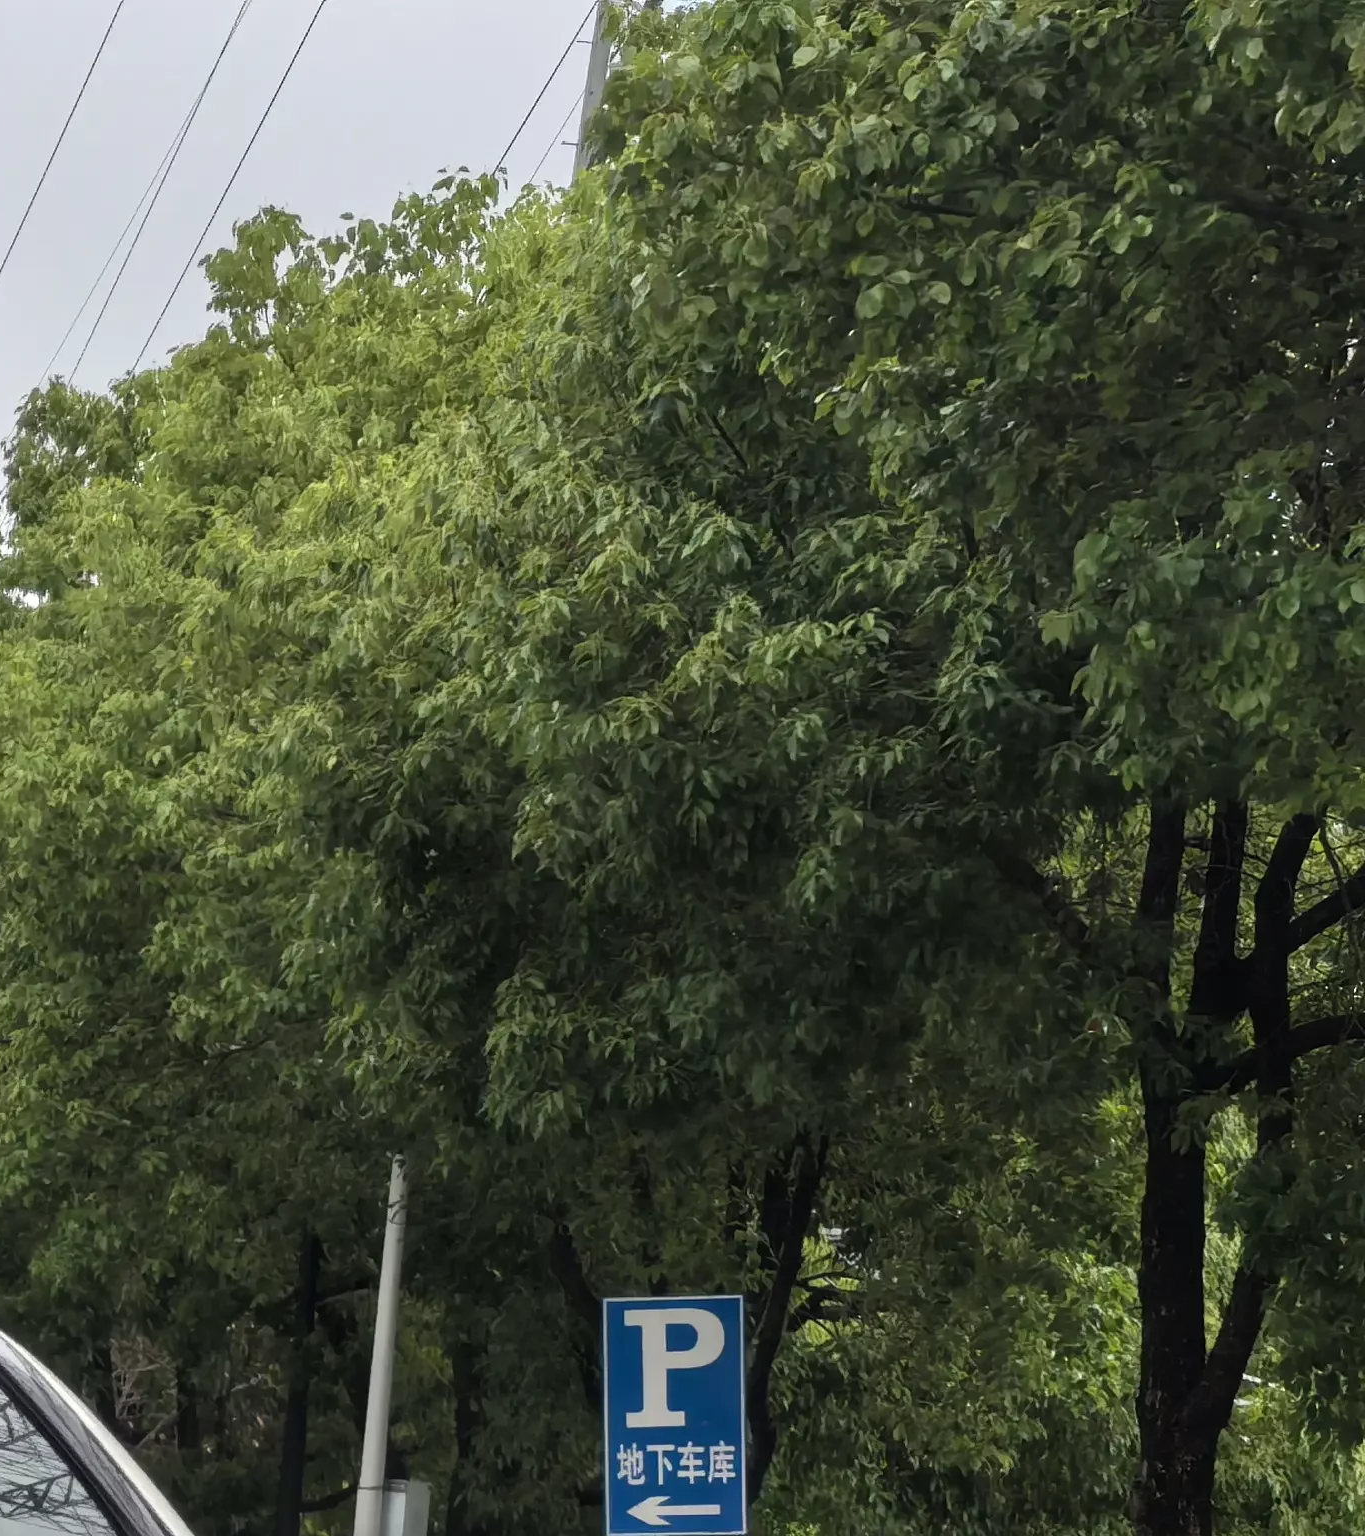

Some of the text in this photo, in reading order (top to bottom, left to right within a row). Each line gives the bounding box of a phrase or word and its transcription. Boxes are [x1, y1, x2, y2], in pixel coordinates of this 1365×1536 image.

[624, 1308, 725, 1428] P
[617, 1440, 736, 1485] 地下车库
